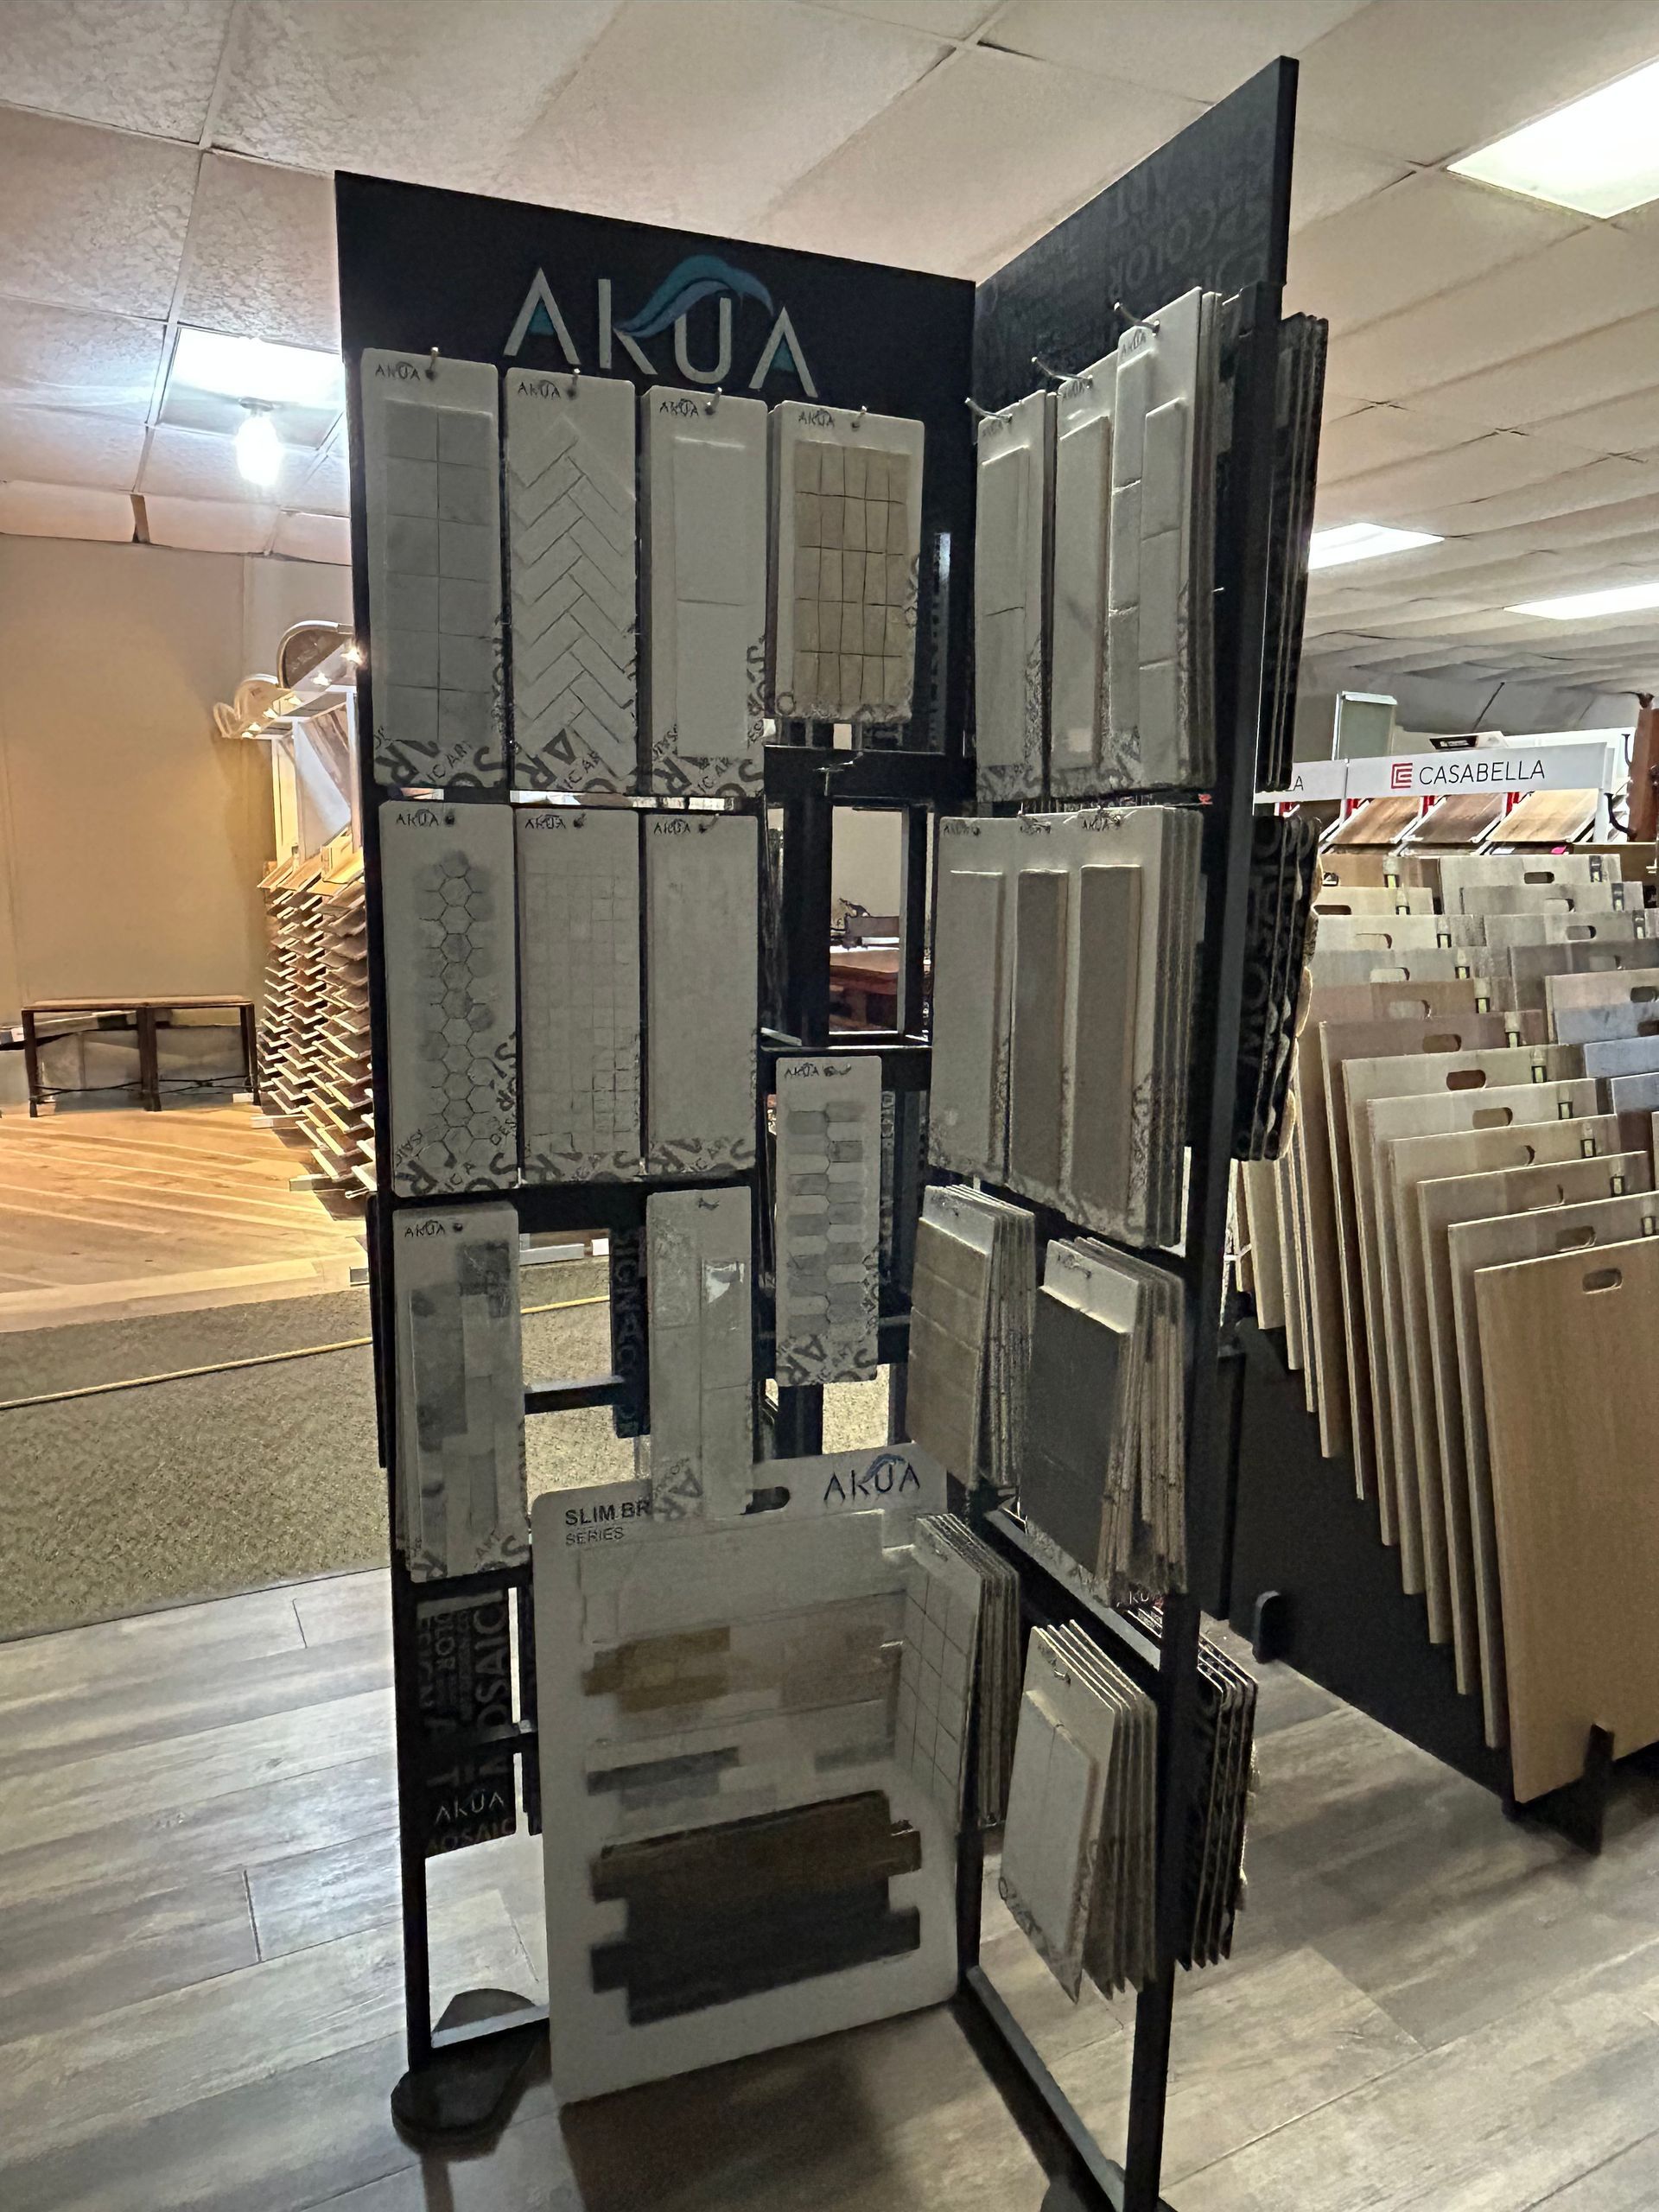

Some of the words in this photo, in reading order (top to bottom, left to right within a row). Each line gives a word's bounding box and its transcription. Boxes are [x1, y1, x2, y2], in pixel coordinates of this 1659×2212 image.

[503, 264, 818, 397] AKUA
[375, 361, 421, 381] AKUA
[518, 380, 561, 398] AKUA
[660, 398, 699, 418] AKUA
[798, 409, 835, 428] AKUA
[1418, 760, 1546, 785] CASABELLA
[396, 809, 439, 827] AKUA
[525, 814, 567, 830] AKUA
[653, 818, 690, 836] AKUA
[784, 1062, 820, 1079] AKUA
[404, 1219, 446, 1238] AKUA
[823, 1456, 921, 1502] AKUA
[564, 1503, 616, 1526] SLIM
[564, 1527, 625, 1547] SERIES
[434, 1789, 505, 1825] AKUA
